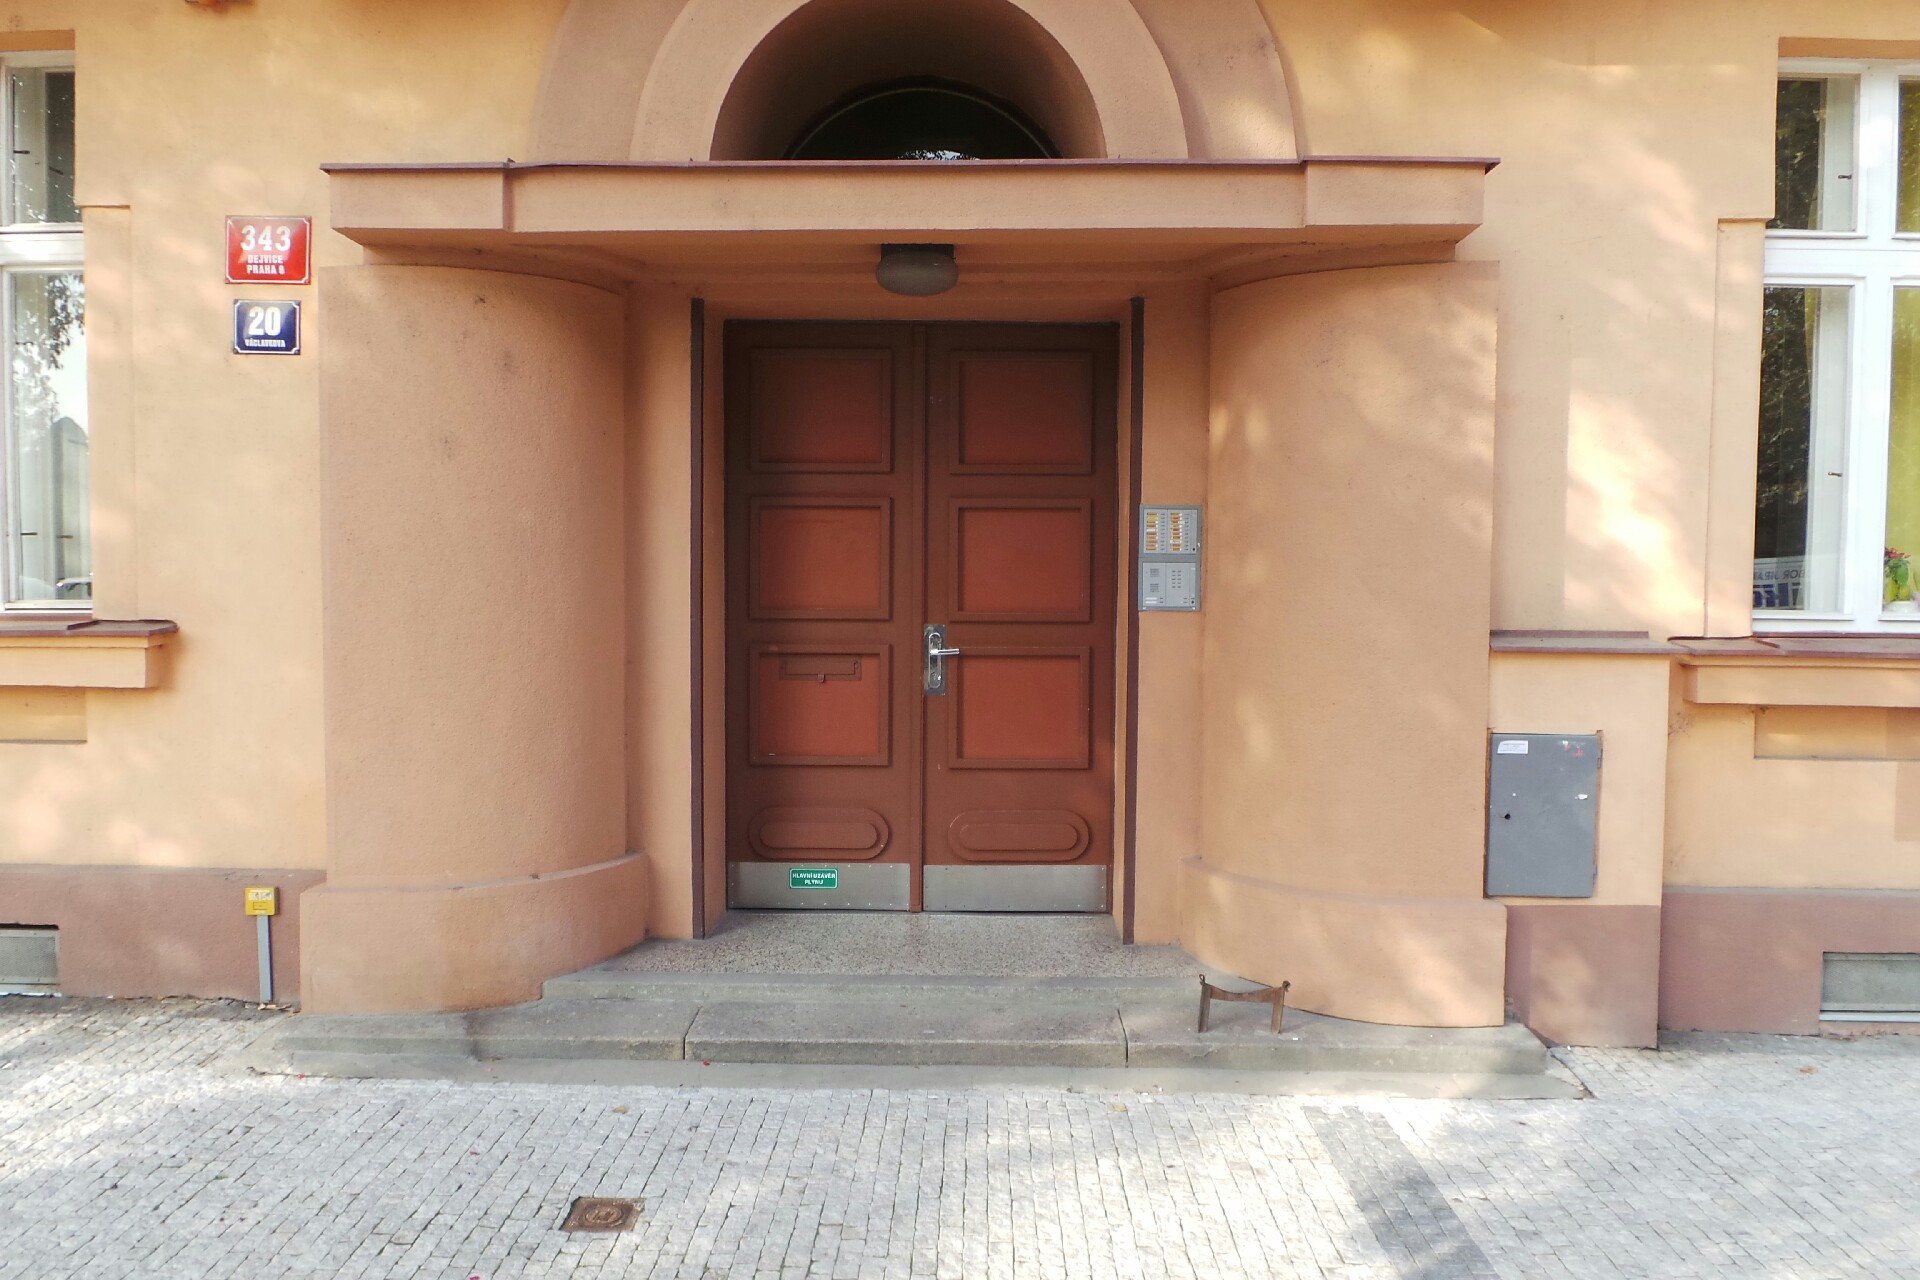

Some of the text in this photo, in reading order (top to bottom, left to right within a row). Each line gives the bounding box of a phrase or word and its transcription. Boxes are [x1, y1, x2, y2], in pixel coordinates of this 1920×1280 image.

[241, 225, 291, 251] 343
[247, 254, 283, 264] DEJVICE
[246, 264, 277, 274] PRAHA
[248, 306, 281, 336] 20
